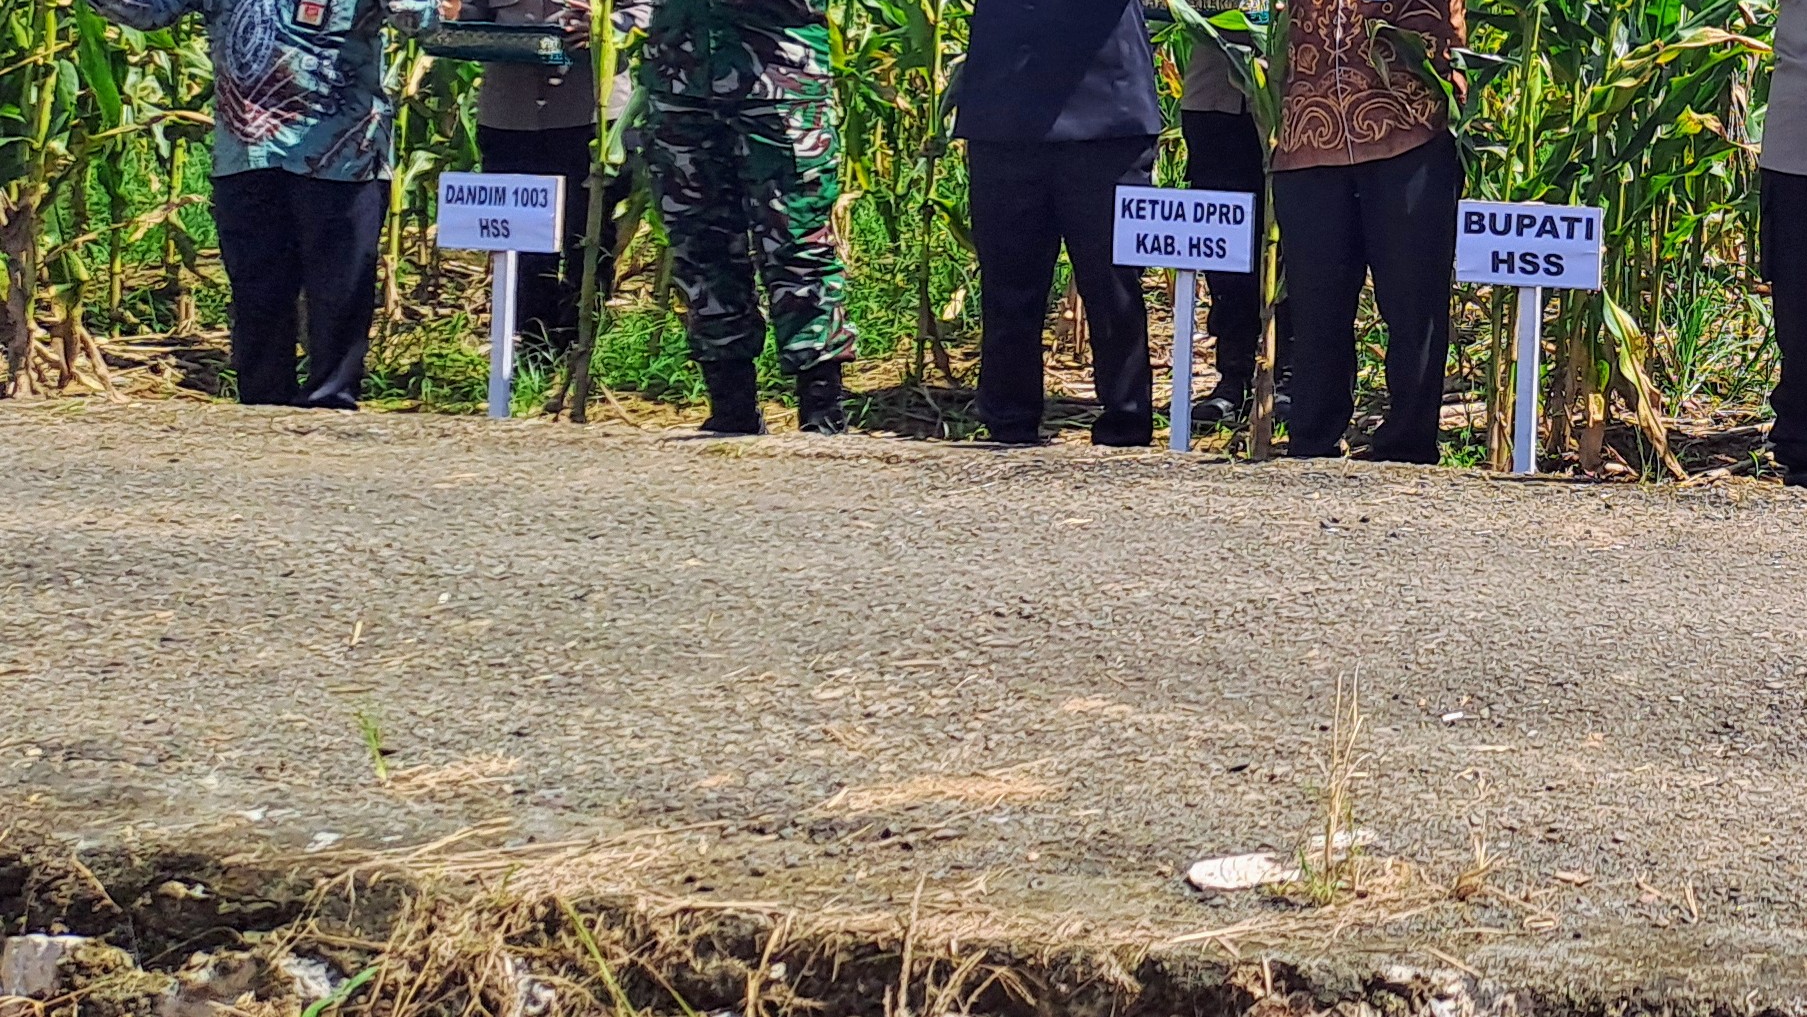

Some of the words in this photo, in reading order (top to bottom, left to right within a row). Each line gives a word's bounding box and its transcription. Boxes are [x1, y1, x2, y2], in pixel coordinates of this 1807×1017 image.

[445, 184, 506, 206] DANDIM
[512, 187, 548, 208] 1003
[1121, 197, 1187, 222] KETUA
[1193, 201, 1245, 225] DPRD
[478, 218, 511, 238] HSS
[1463, 211, 1594, 241] BUPATI
[1135, 232, 1182, 256] KAB.
[1188, 236, 1227, 259] HSS
[1491, 250, 1565, 277] HSS
